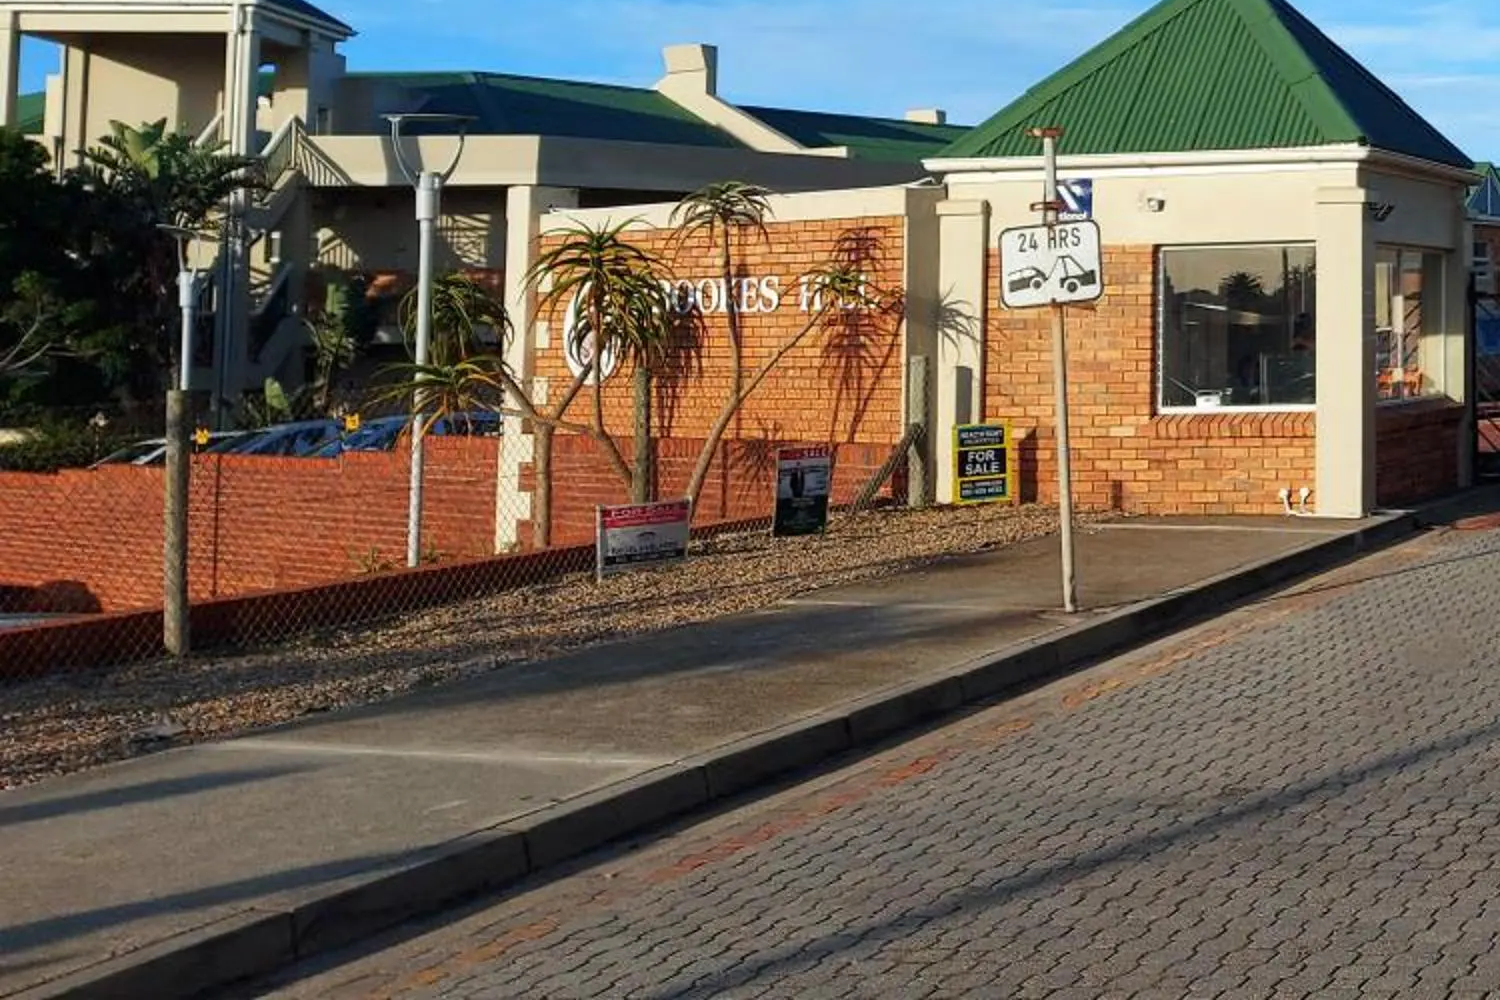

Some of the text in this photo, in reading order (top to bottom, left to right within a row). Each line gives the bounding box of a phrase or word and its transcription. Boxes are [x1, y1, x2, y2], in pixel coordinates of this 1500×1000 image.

[1017, 227, 1081, 253] 24 HRS
[651, 275, 780, 314] OOKES
[967, 450, 995, 463] FOR
[964, 461, 1001, 476] SALE
